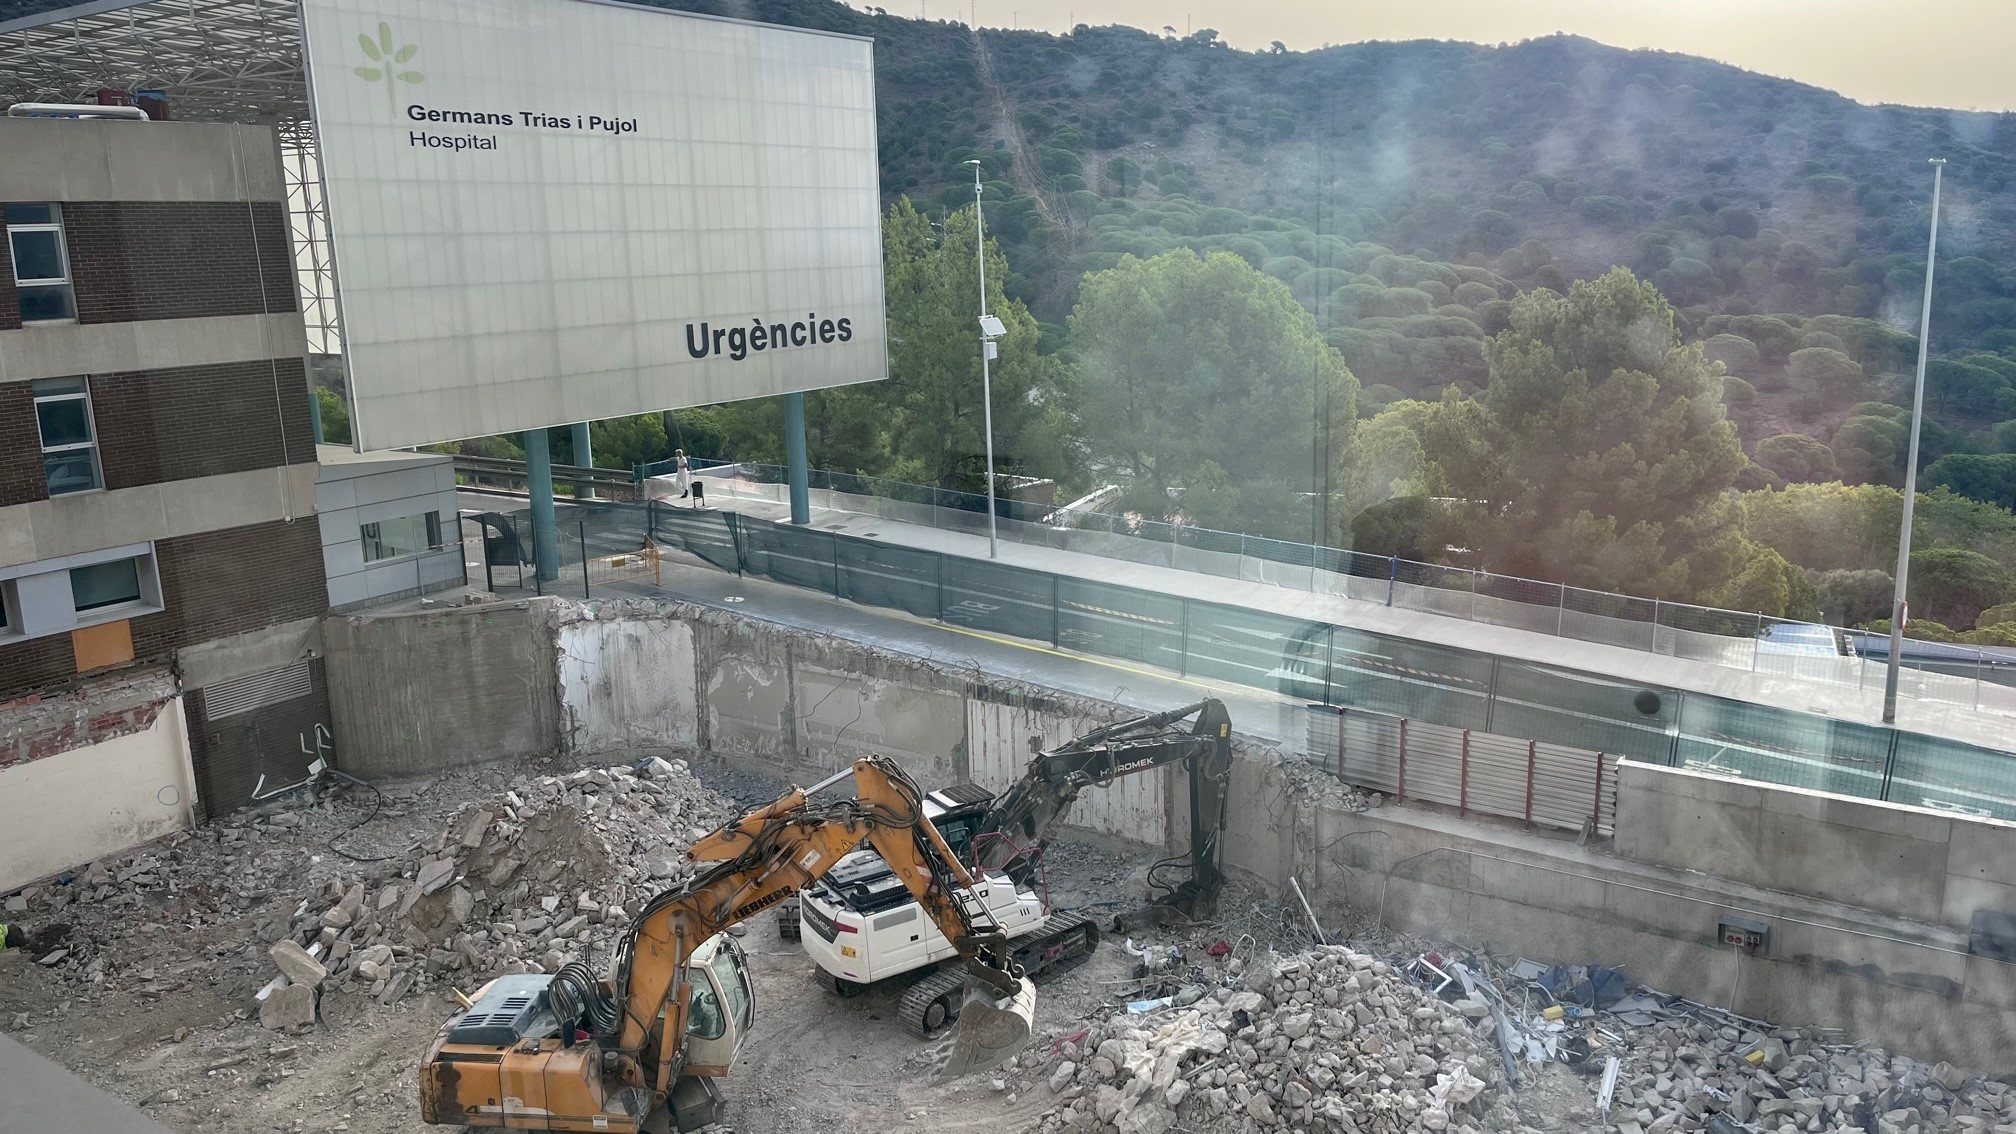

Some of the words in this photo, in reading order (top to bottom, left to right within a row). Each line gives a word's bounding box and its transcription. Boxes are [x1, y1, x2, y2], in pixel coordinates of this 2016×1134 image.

[407, 104, 513, 126] Germans
[518, 111, 571, 129] Trias
[577, 115, 583, 129] i
[589, 115, 638, 134] Pujol
[409, 130, 497, 152] Hospital
[686, 313, 853, 361] Urgències
[732, 885, 793, 920] LIEBHERR
